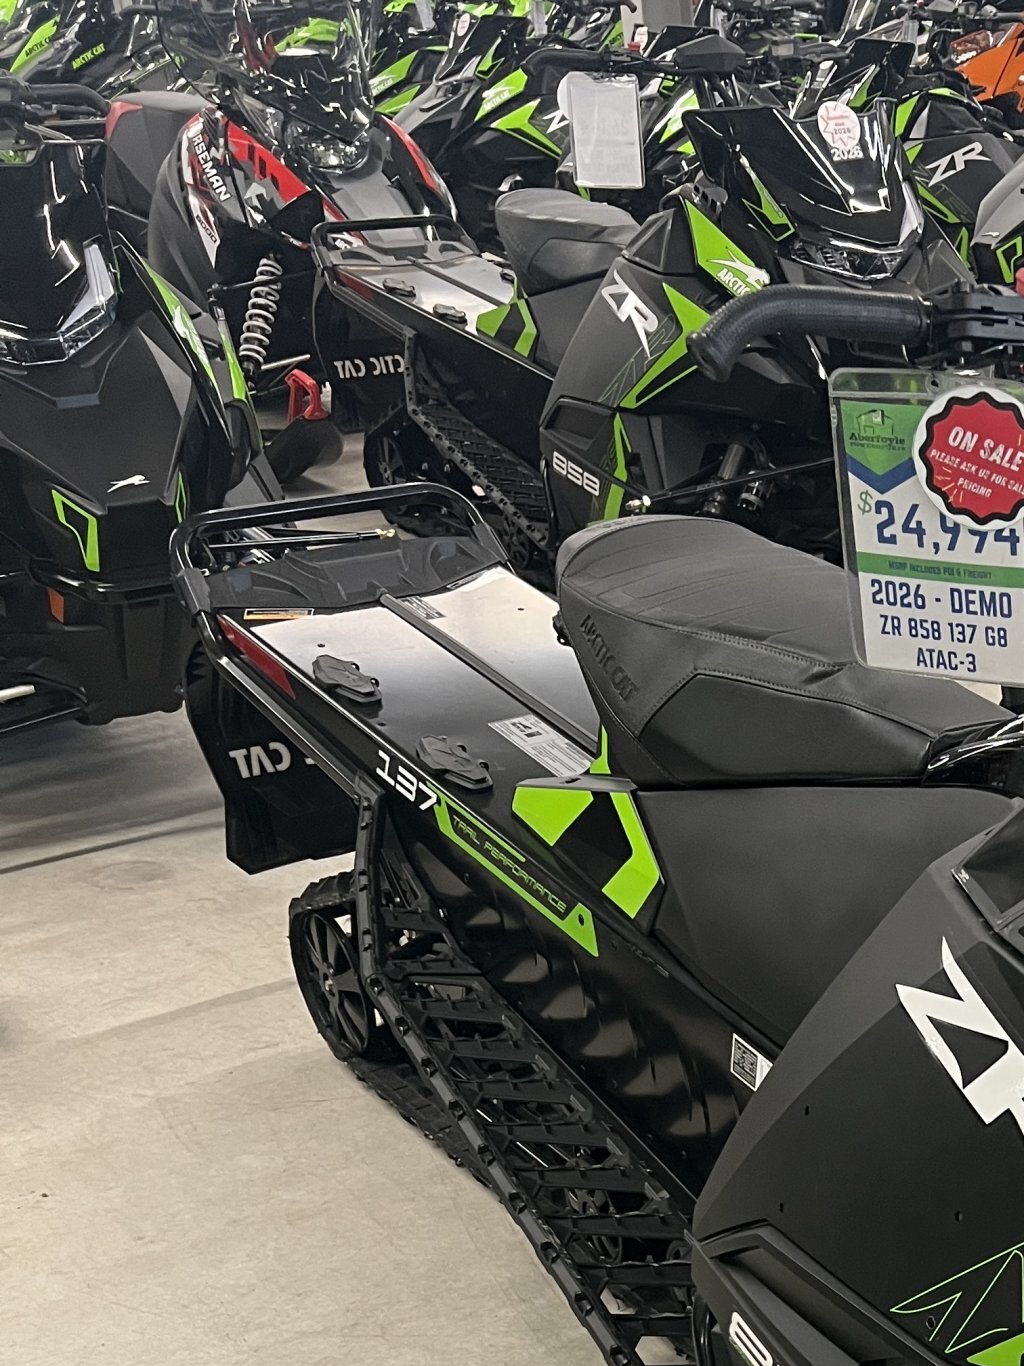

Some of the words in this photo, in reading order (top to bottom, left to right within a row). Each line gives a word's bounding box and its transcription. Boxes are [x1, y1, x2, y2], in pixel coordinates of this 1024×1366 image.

[25, 39, 45, 57] ARCTIC
[72, 49, 94, 70] ARCTIC
[92, 43, 105, 59] CAT
[830, 146, 865, 161] 2026
[926, 142, 993, 187] ZR
[600, 269, 659, 358] ZR
[849, 432, 905, 446] Aberfoyle
[948, 426, 979, 453] ON
[553, 451, 600, 498] 858
[930, 448, 960, 470] PLEASE
[960, 461, 977, 475] ASK
[978, 466, 991, 480] US
[991, 470, 1007, 486] FOR
[957, 477, 993, 498] PRICING
[870, 578, 927, 610] 2026
[949, 587, 1013, 619] DEMO
[879, 614, 902, 637] ZR
[907, 617, 942, 641] 858
[947, 622, 977, 645] 137
[580, 614, 616, 675] ARCTIC
[610, 665, 641, 702] CAT
[916, 647, 977, 673] ATAC-3
[375, 749, 438, 811] 137
[452, 814, 481, 845] TRAIL
[483, 839, 568, 913] PERFORMANCE
